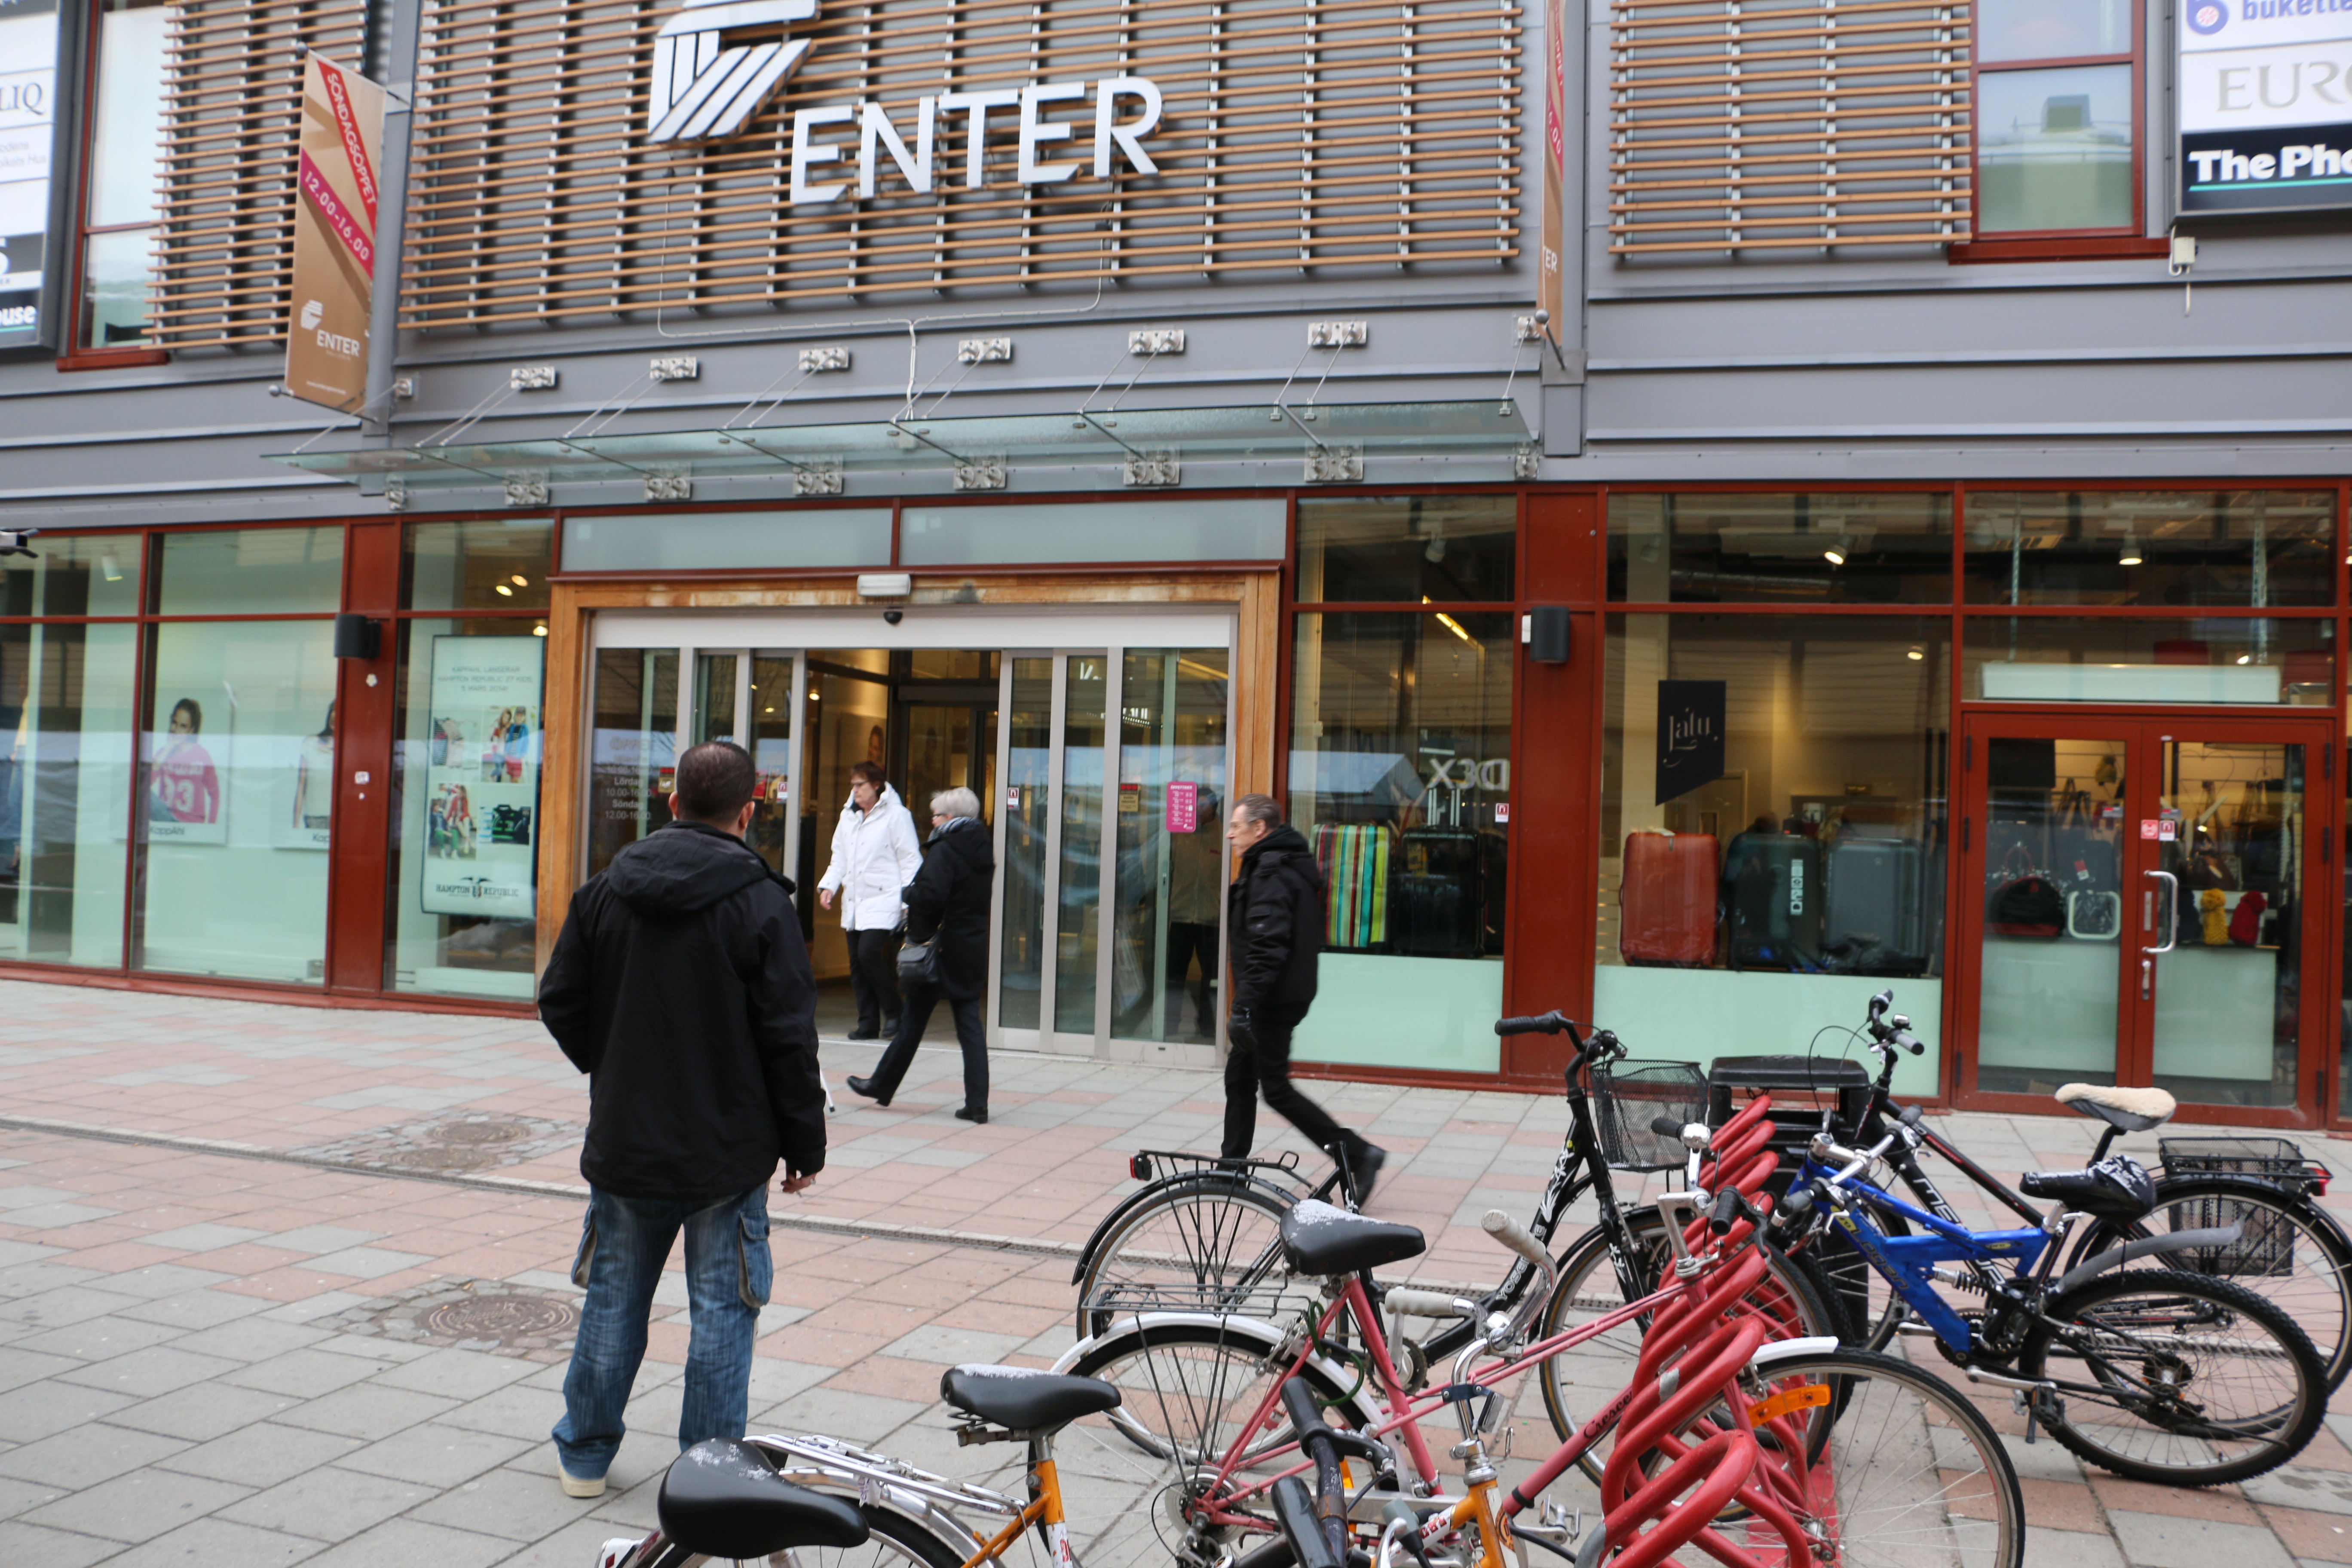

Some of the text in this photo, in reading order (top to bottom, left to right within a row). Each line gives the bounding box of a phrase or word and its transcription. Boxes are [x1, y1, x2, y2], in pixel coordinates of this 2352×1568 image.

[328, 72, 377, 204] SÖNDAGSÖPPET
[790, 76, 1162, 204] ENTER
[2189, 149, 2276, 182] The
[305, 171, 370, 261] 12.00-16.00
[316, 329, 360, 357] ENTER
[436, 884, 519, 897] HAMPTON REPUBLIC
[1583, 1391, 1632, 1439] Cresce
